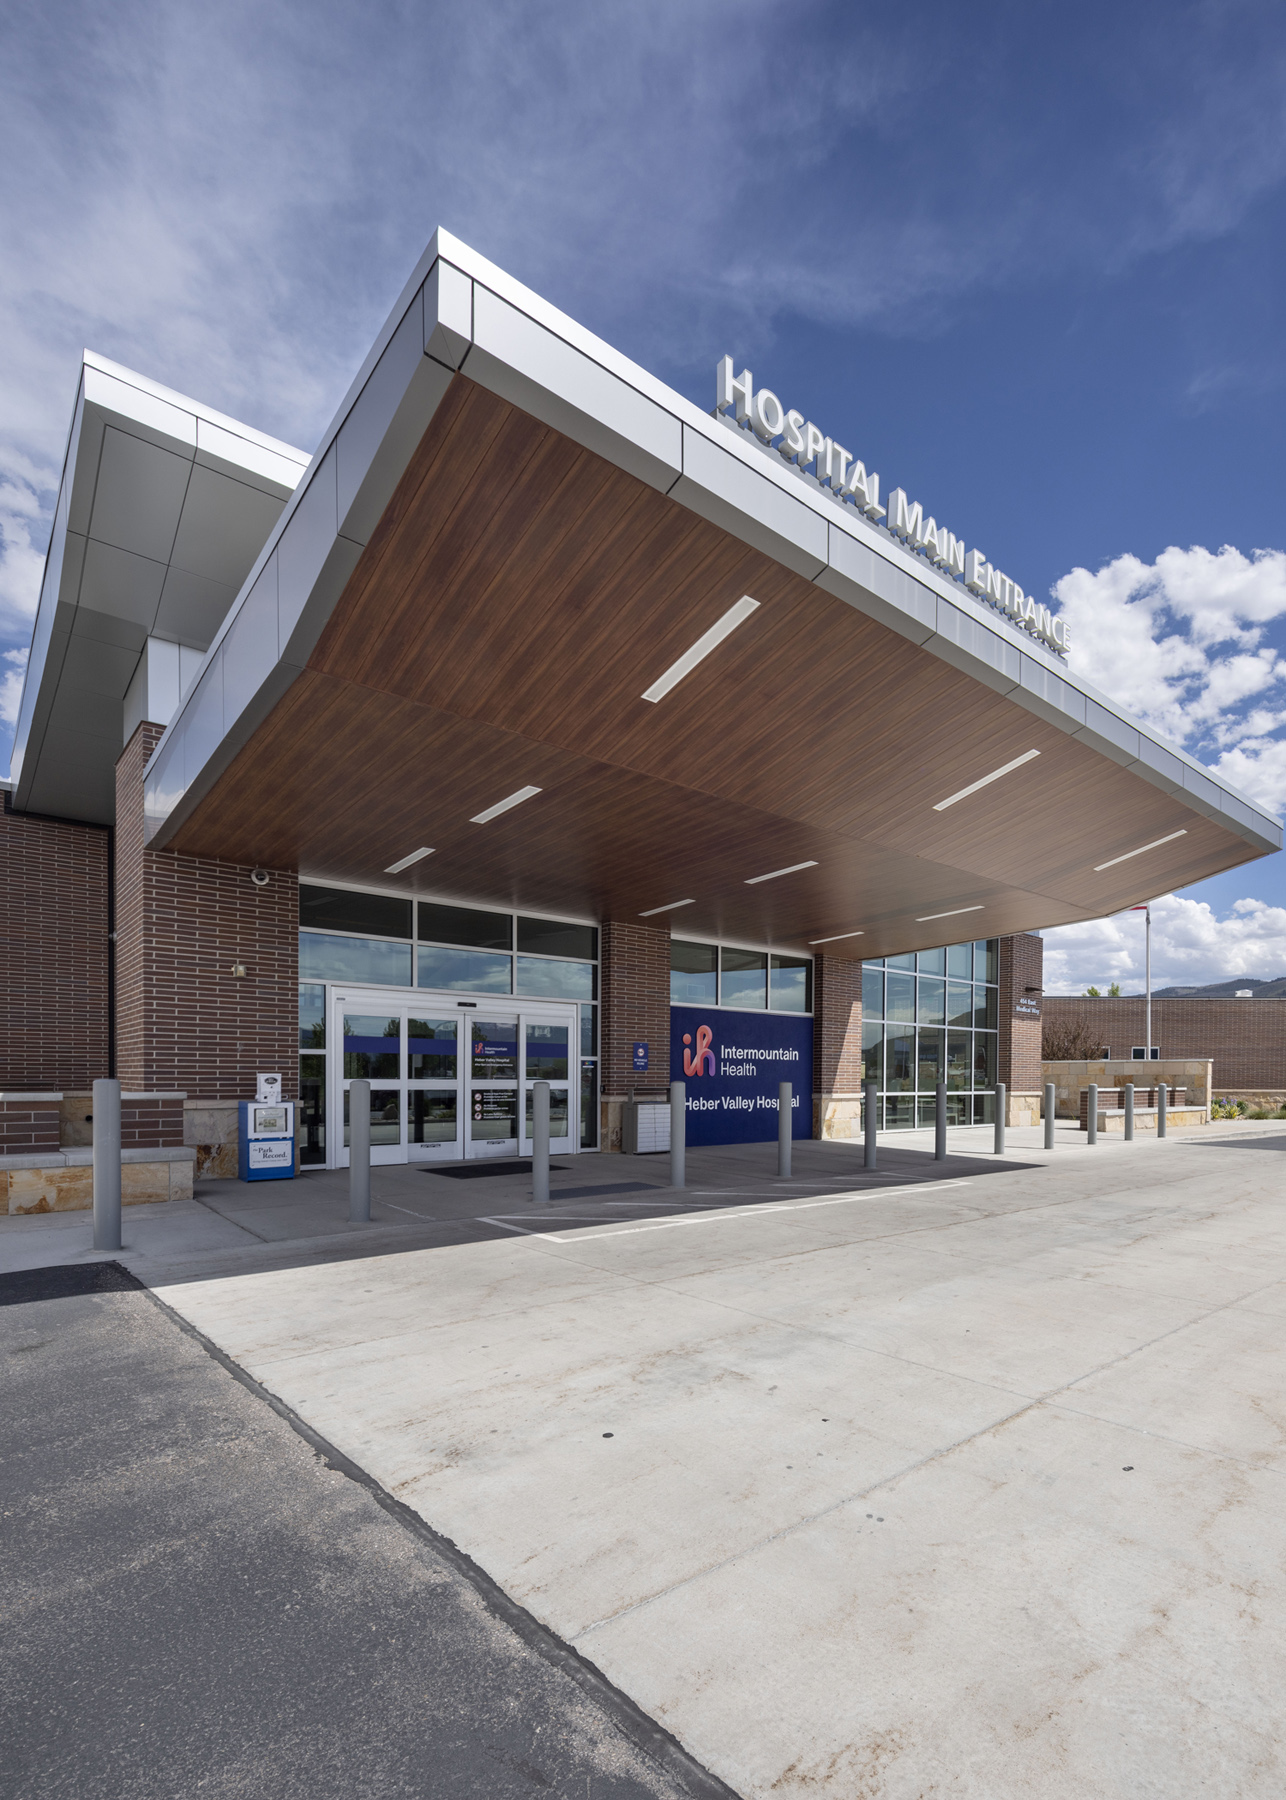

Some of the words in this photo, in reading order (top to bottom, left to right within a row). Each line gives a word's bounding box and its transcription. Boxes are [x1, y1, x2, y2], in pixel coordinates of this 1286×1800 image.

[716, 353, 887, 520] HOSPITAL
[888, 487, 965, 577] MAIN
[965, 548, 1072, 656] ENTRANCE
[721, 1045, 799, 1060] Intermountain
[720, 1062, 757, 1076] Health
[685, 1096, 720, 1111] Heber
[721, 1096, 755, 1112] Valley
[756, 1094, 800, 1111] Hosal
[258, 1146, 273, 1154] Park
